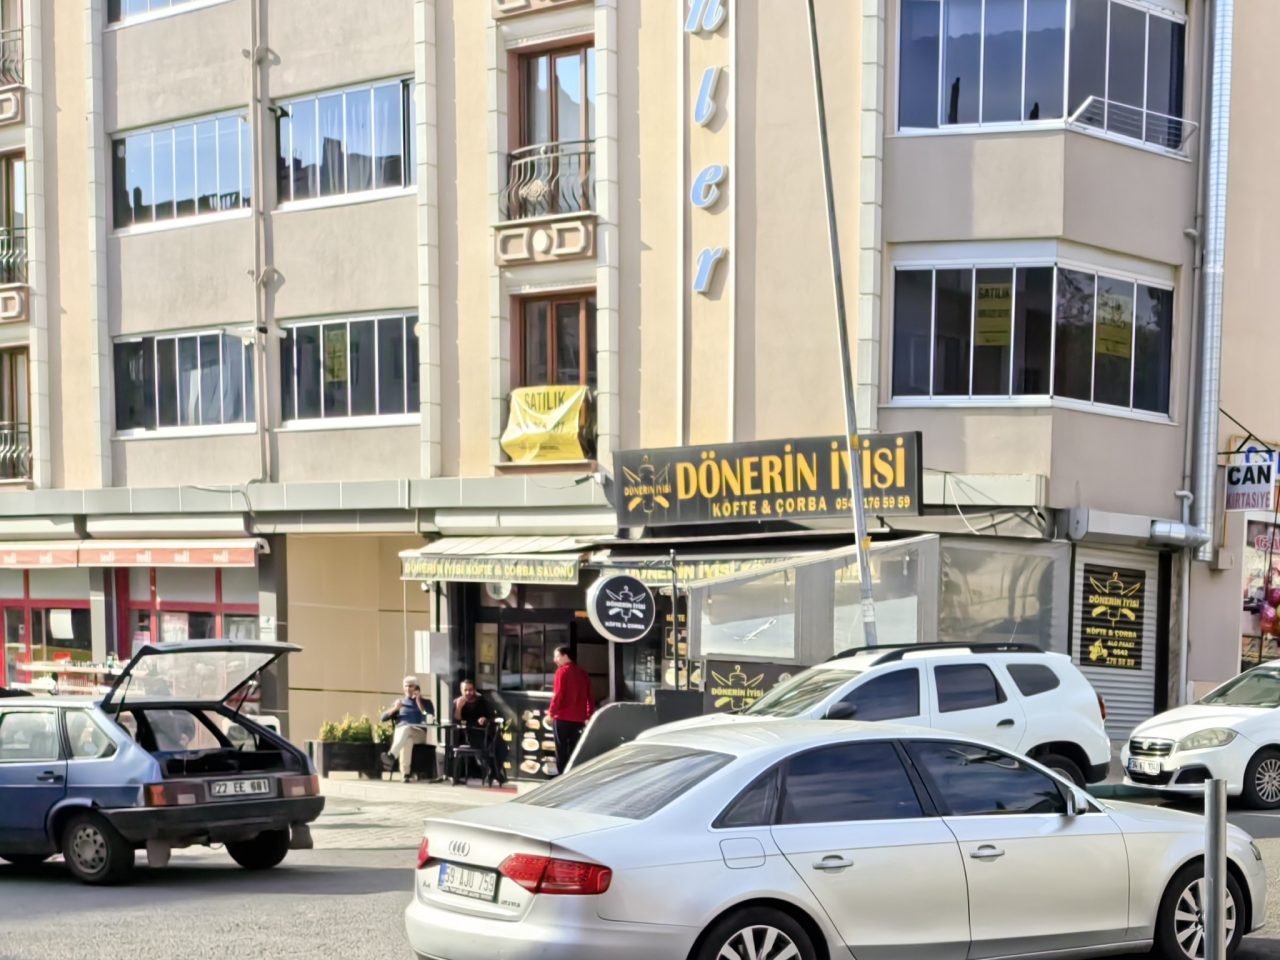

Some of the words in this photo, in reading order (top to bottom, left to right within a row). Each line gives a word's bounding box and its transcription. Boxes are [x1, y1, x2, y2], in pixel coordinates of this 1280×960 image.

[524, 391, 566, 412] SATILIK
[675, 444, 817, 500] DÖNERİN
[1227, 465, 1271, 485] CAN
[712, 498, 757, 517] KÖFTE
[762, 500, 771, 514] &
[775, 496, 827, 518] ÇORBA
[882, 496, 895, 508] 59
[898, 495, 911, 508] 59
[711, 686, 746, 697] DÖNERİN
